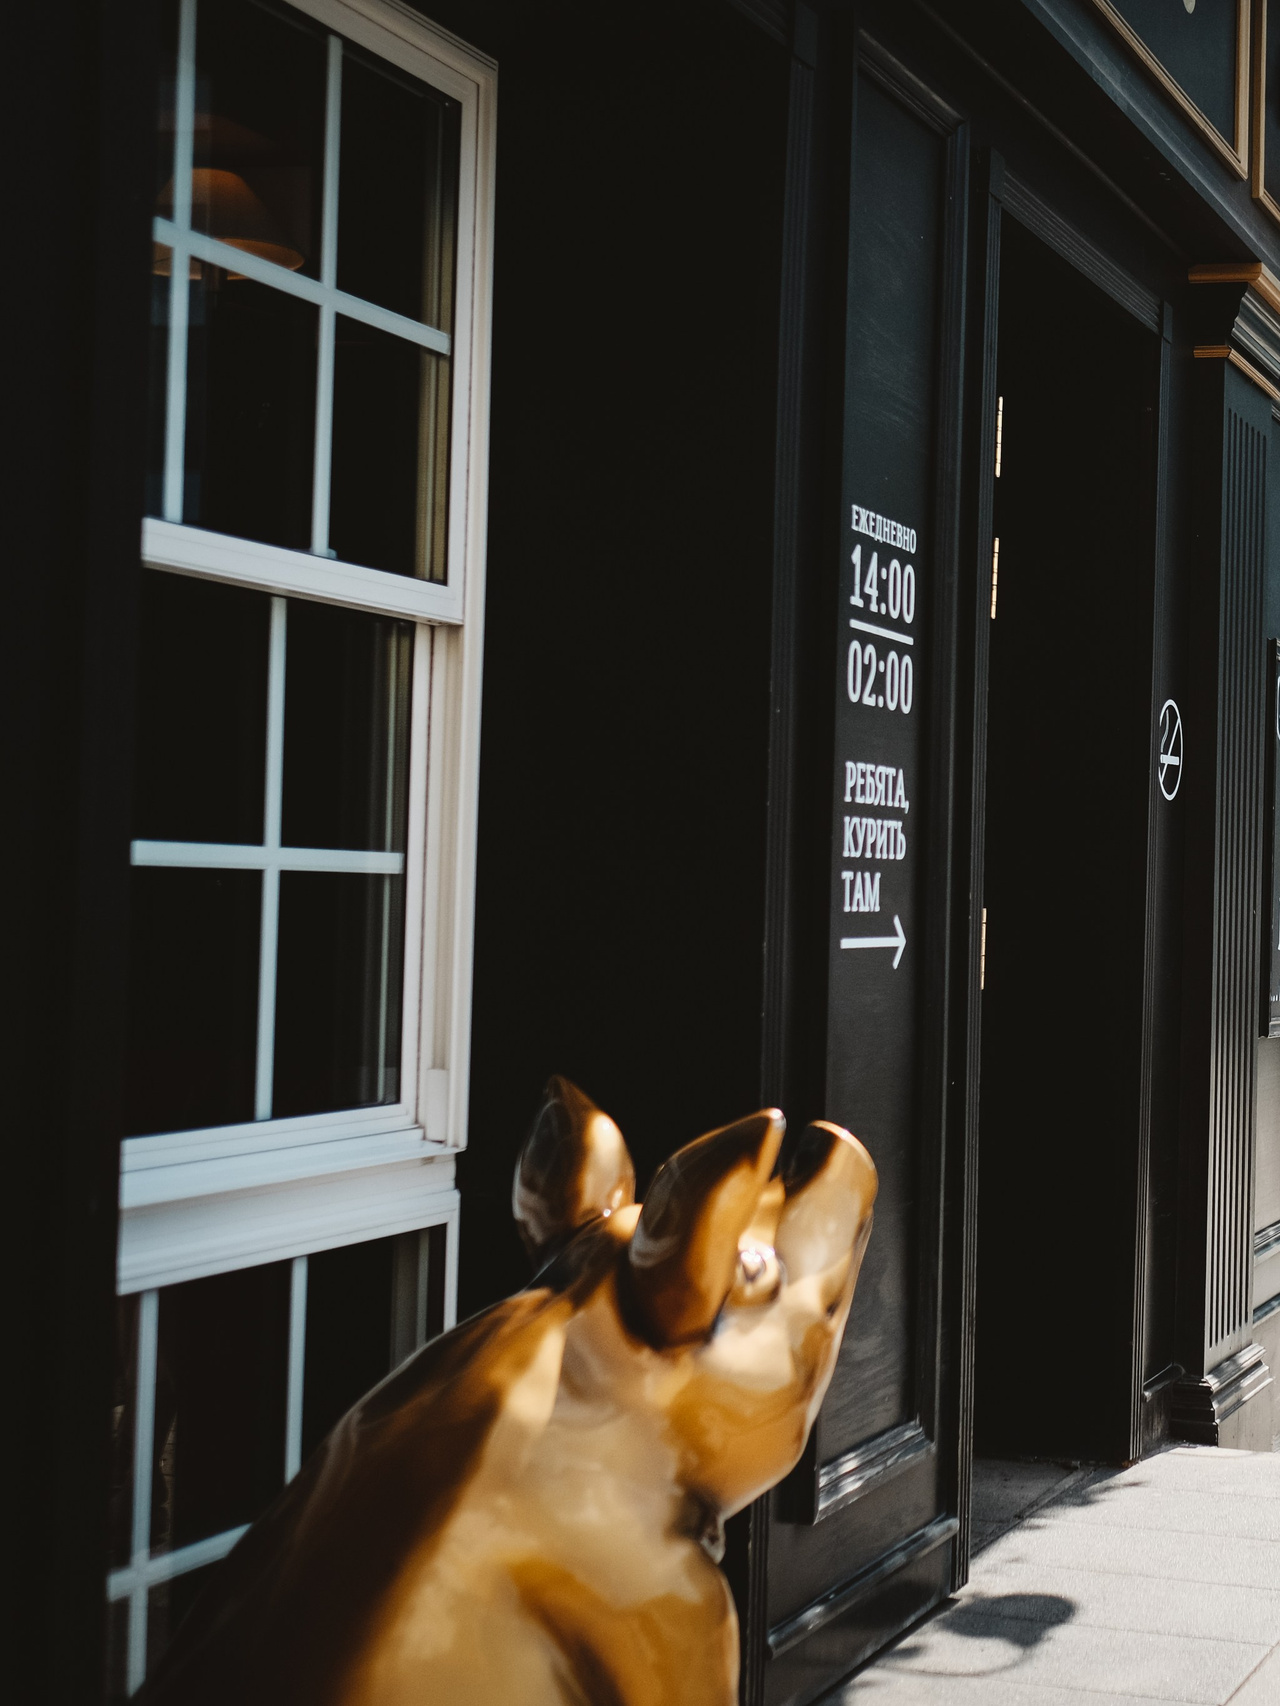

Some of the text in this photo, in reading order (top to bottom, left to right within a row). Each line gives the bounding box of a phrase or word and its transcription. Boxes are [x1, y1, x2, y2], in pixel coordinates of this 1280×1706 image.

[851, 504, 917, 554] ЕЖЕДНЕВНО
[849, 544, 916, 624] 14:00
[847, 639, 914, 715] 02:00
[844, 761, 910, 815] РЕБЯТА,
[842, 815, 907, 861] КУРИТЬ
[841, 870, 882, 913] ТАМ
